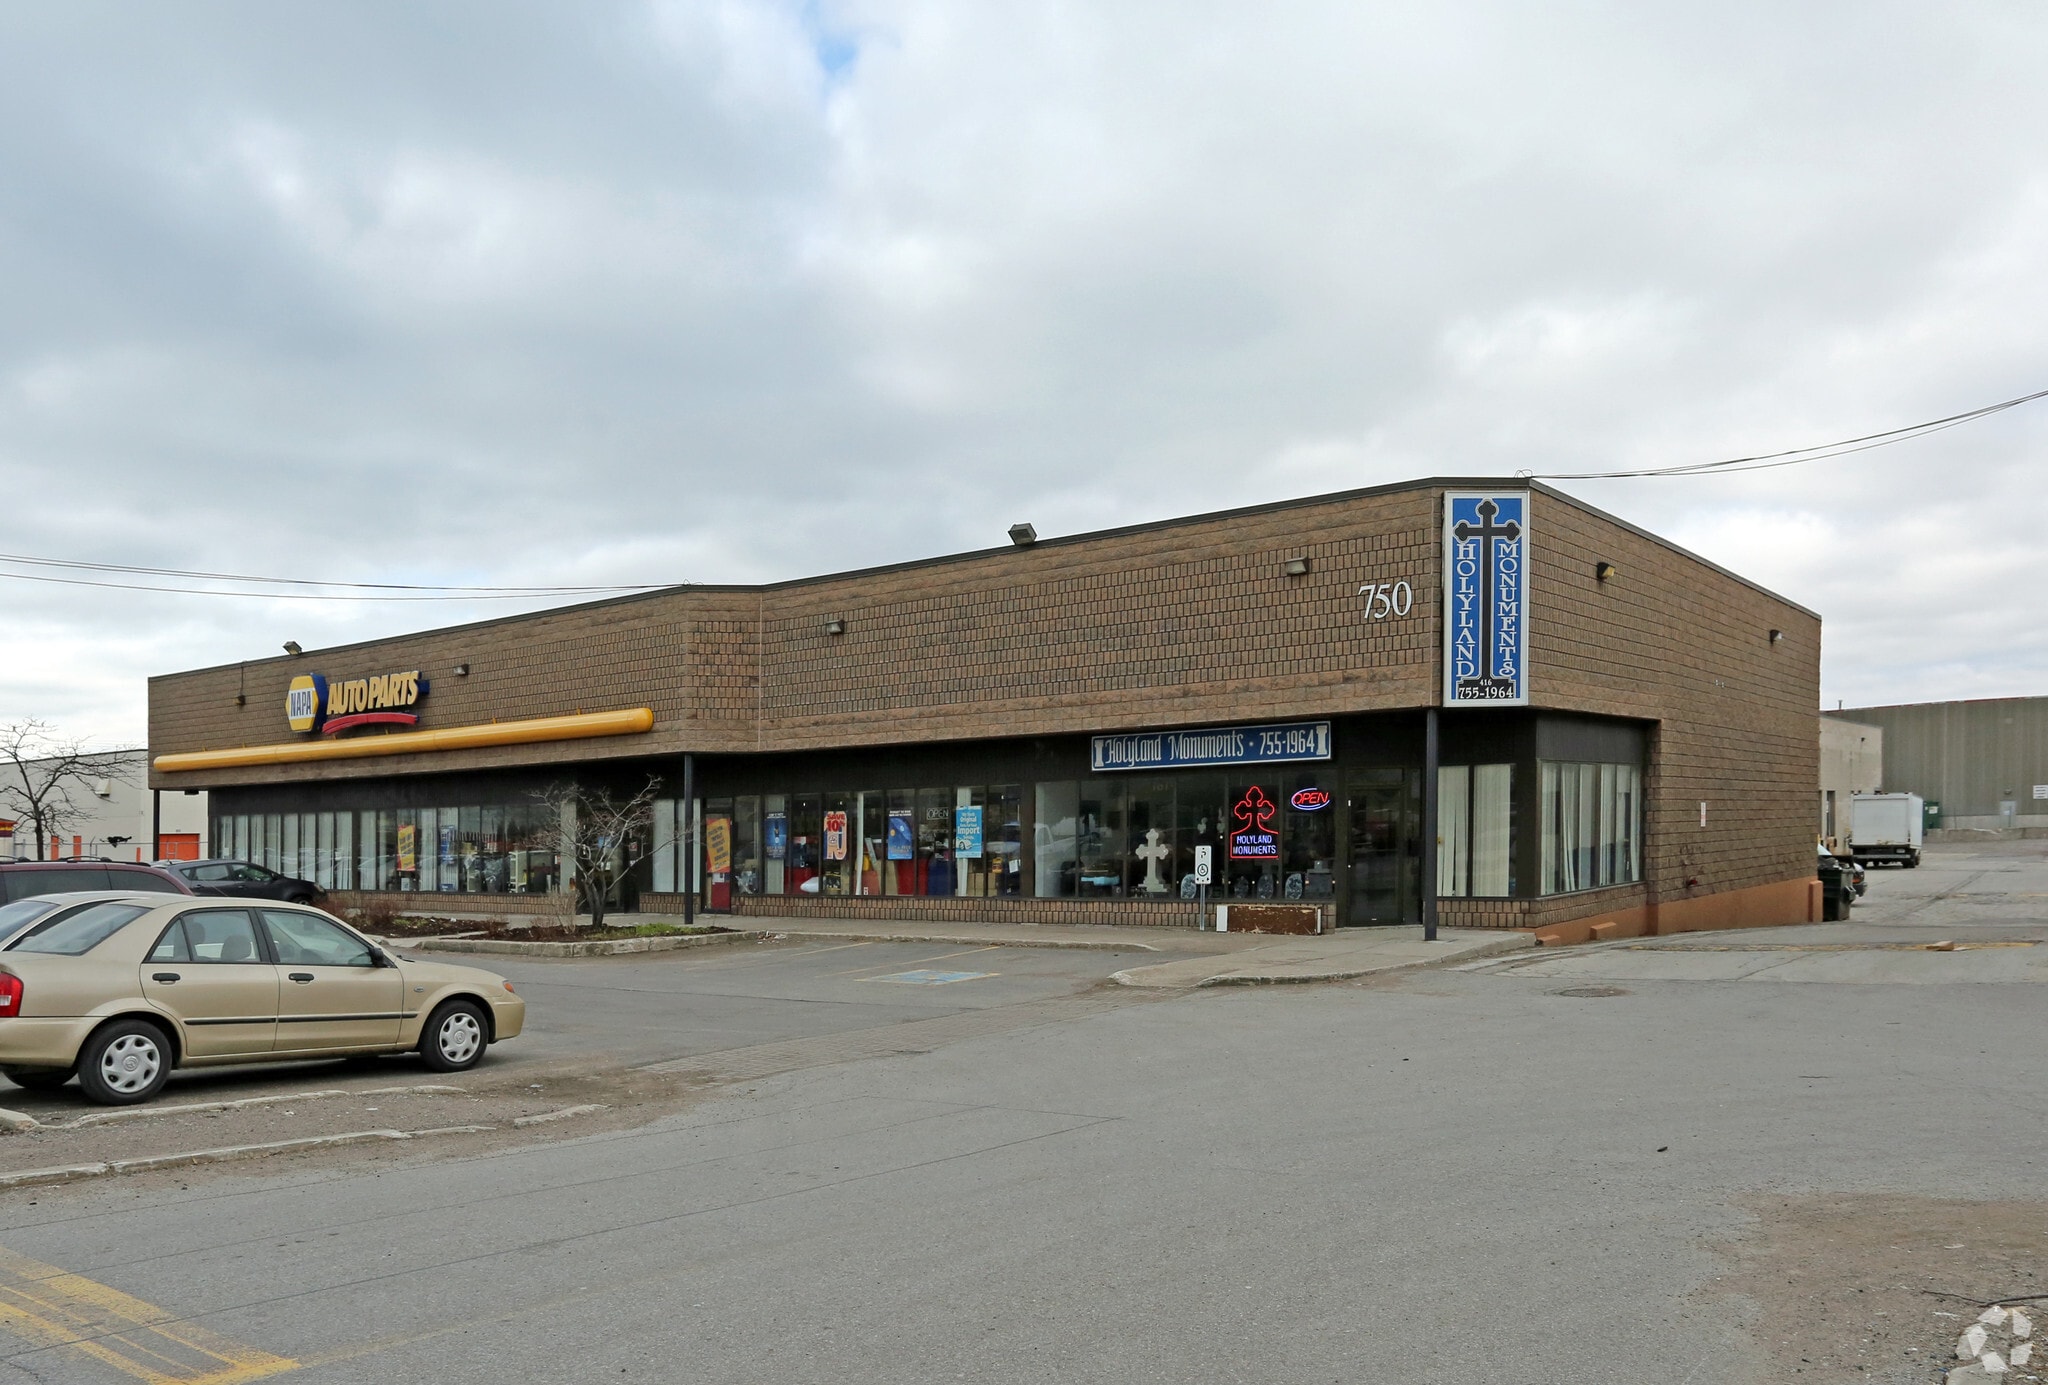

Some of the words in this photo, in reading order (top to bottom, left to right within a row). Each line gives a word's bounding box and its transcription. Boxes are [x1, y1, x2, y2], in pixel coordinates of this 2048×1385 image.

[1357, 581, 1412, 619] 750
[1498, 543, 1519, 677] MONUMENTS
[1456, 543, 1476, 678] HOLYLAND
[326, 679, 369, 716] AUTO
[367, 670, 420, 709] PARTS
[1459, 686, 1514, 699] 755-1964
[290, 690, 312, 717] NAPA
[1104, 734, 1162, 767] Holyland
[1168, 730, 1244, 761] Monuments
[1259, 729, 1316, 756] 755-1964
[1294, 792, 1329, 804] OPEN
[929, 808, 949, 818] OPEN
[957, 826, 980, 836] Import
[1236, 835, 1273, 845] HOLYLAND
[1233, 845, 1277, 855] MONUMENTS
